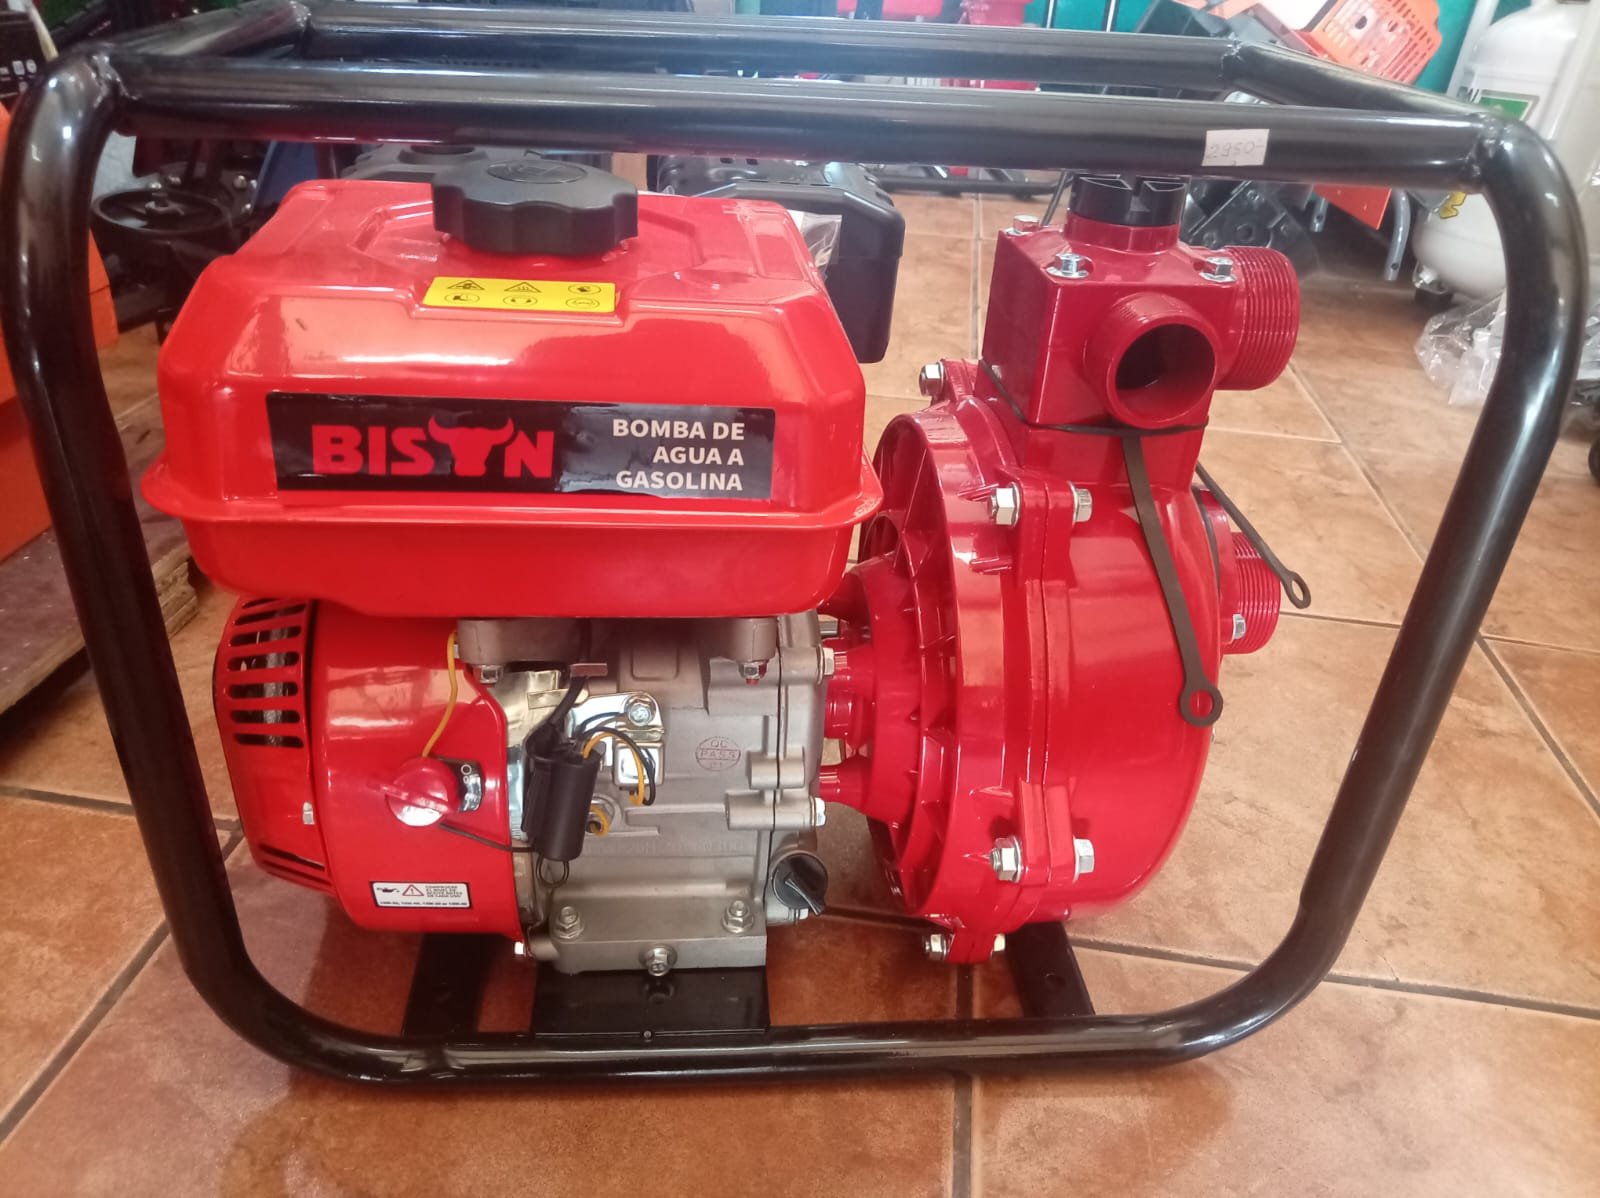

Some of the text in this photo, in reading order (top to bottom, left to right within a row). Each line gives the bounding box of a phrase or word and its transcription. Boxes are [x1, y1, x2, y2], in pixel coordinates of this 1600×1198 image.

[612, 418, 745, 441] BOMBA DE
[653, 445, 745, 466] AGUA A
[615, 470, 743, 492] GASOLINA
